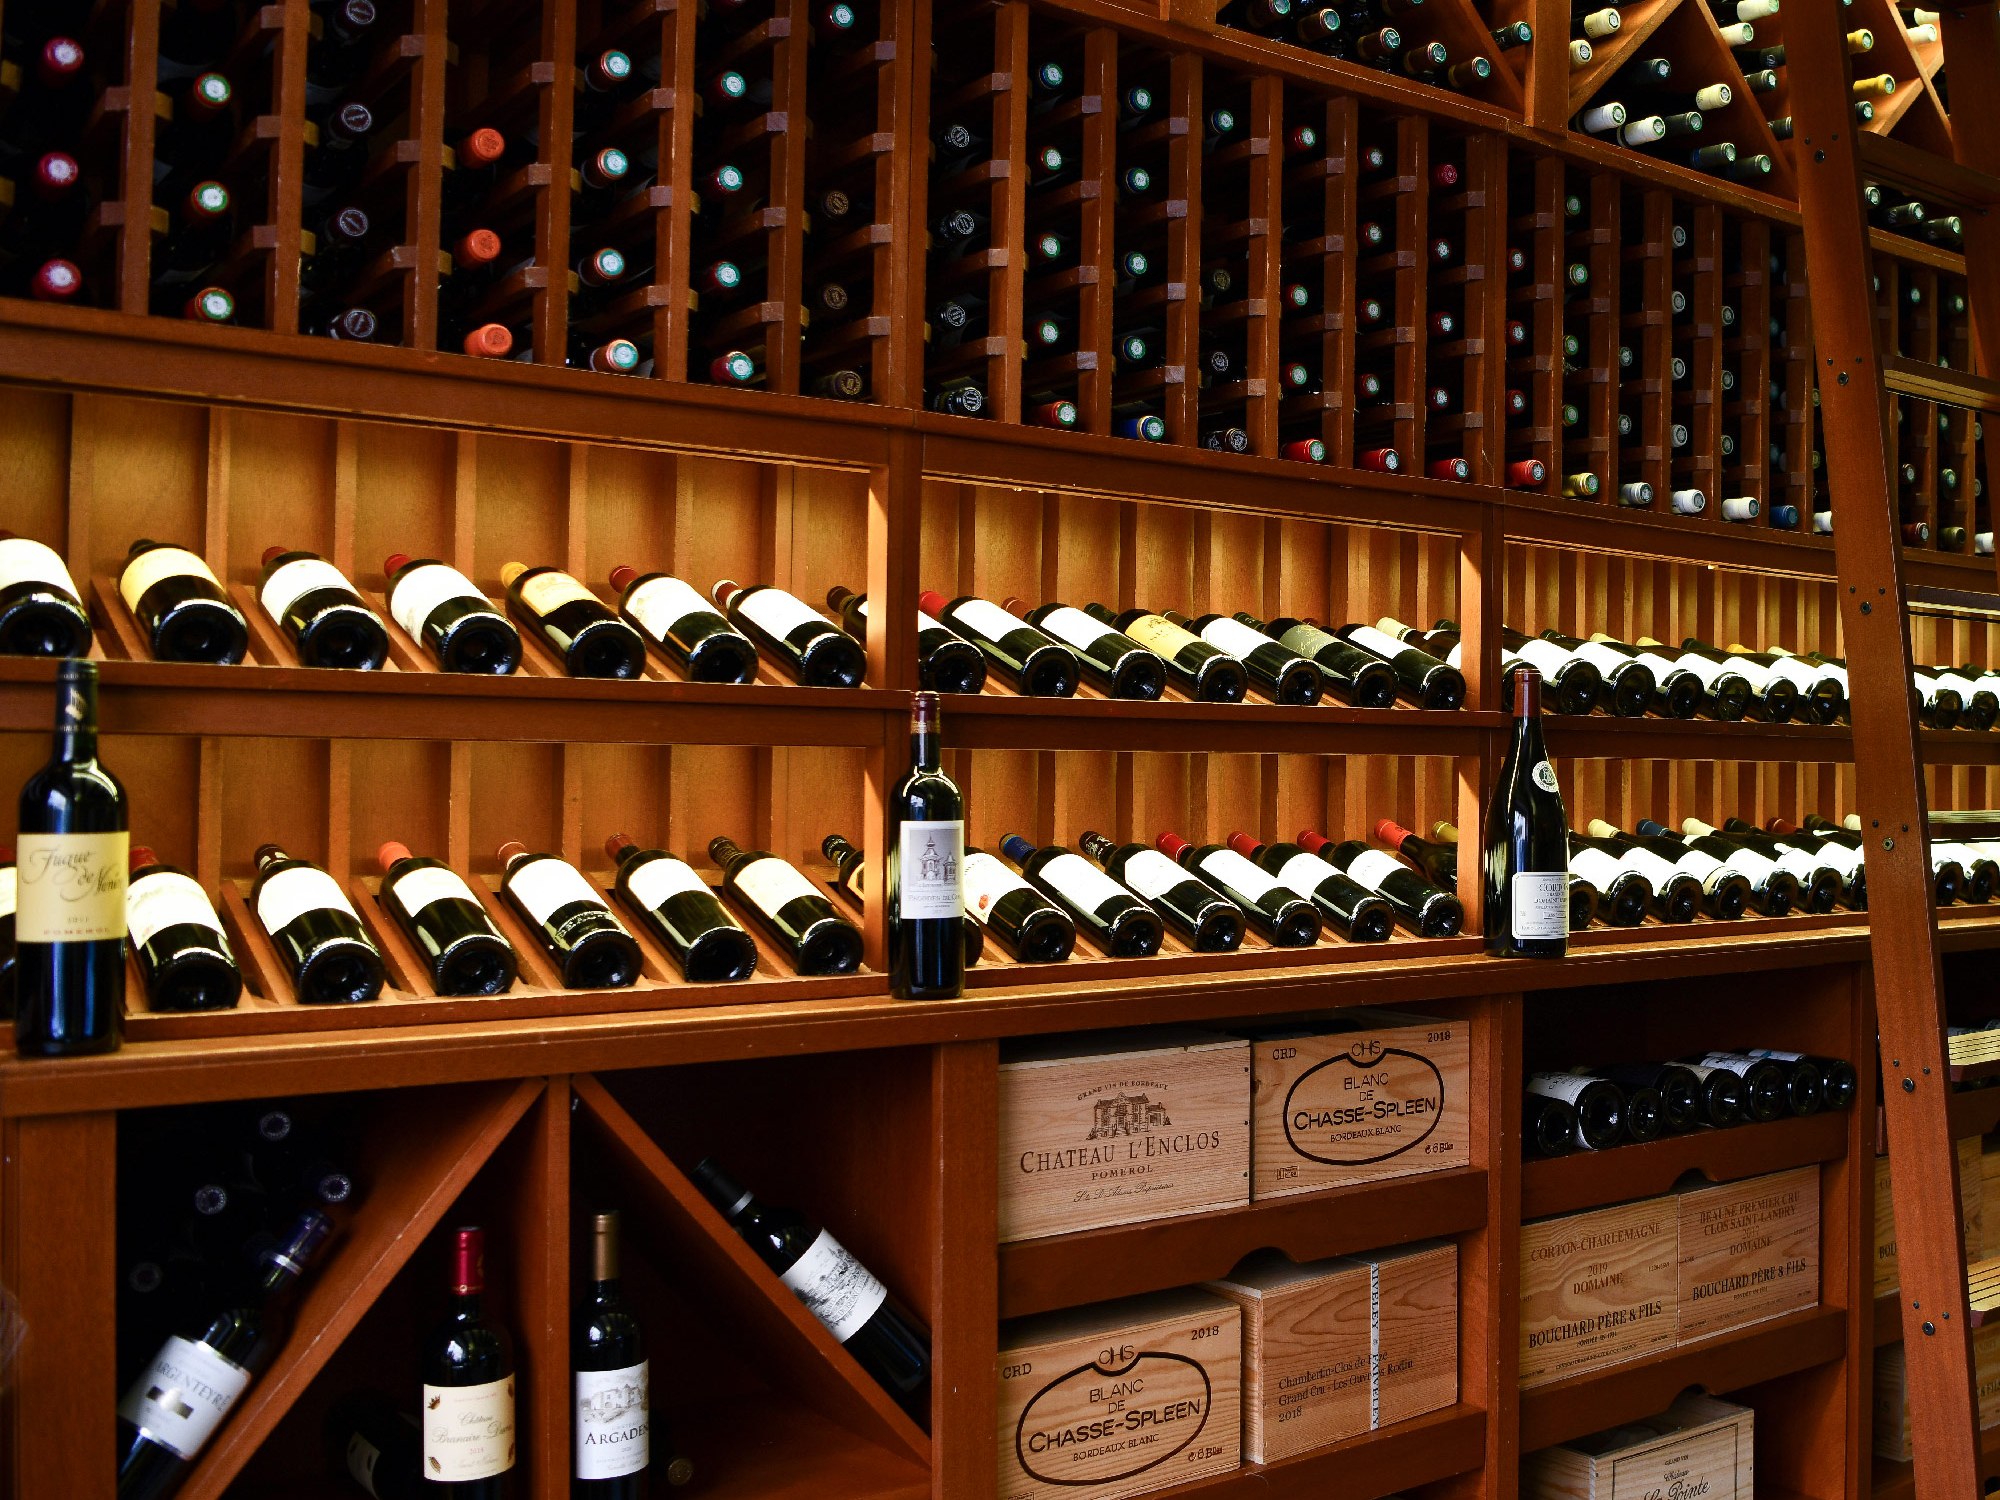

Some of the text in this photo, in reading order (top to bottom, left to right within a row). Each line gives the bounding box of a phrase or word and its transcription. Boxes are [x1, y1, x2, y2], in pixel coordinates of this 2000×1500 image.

[1427, 1031, 1451, 1043] 2018
[1119, 1080, 1129, 1088] DE
[1344, 1072, 1389, 1090] BLANC
[1359, 1089, 1374, 1101] DE
[1293, 1097, 1436, 1130] CHASSE-SPLEEN
[1330, 1124, 1402, 1143] BORDEAUX BLANC
[1020, 1130, 1220, 1174] CHATEAU L'ENCLOS
[1091, 1164, 1153, 1181] POMEROL
[1700, 1191, 1800, 1224] BEAUNE PREMIER CRU
[1704, 1221, 1729, 1236] CLOS
[1729, 1235, 1773, 1256] DOMAINE
[1587, 1262, 1608, 1278] 2019
[1692, 1274, 1750, 1302] BOUCHARD
[1751, 1266, 1776, 1286] PÈRE
[1786, 1257, 1806, 1275] FILS
[1573, 1272, 1624, 1295] DOMAINE
[1191, 1325, 1220, 1341] 2018
[1528, 1300, 1662, 1349] BOUCHARD PÈRE & FILS
[1354, 1356, 1366, 1370] de
[1089, 1378, 1144, 1404] BLANC
[1278, 1390, 1309, 1407] Grand
[1310, 1385, 1327, 1398] Cru
[1333, 1379, 1348, 1392] Les
[1372, 1353, 1380, 1427] FAIVELEY
[1108, 1399, 1126, 1414] DE
[1278, 1406, 1303, 1423] 2018
[1028, 1398, 1201, 1453] CHASSE-SPLEEN
[1073, 1433, 1160, 1462] BORDEAUX BLANC
